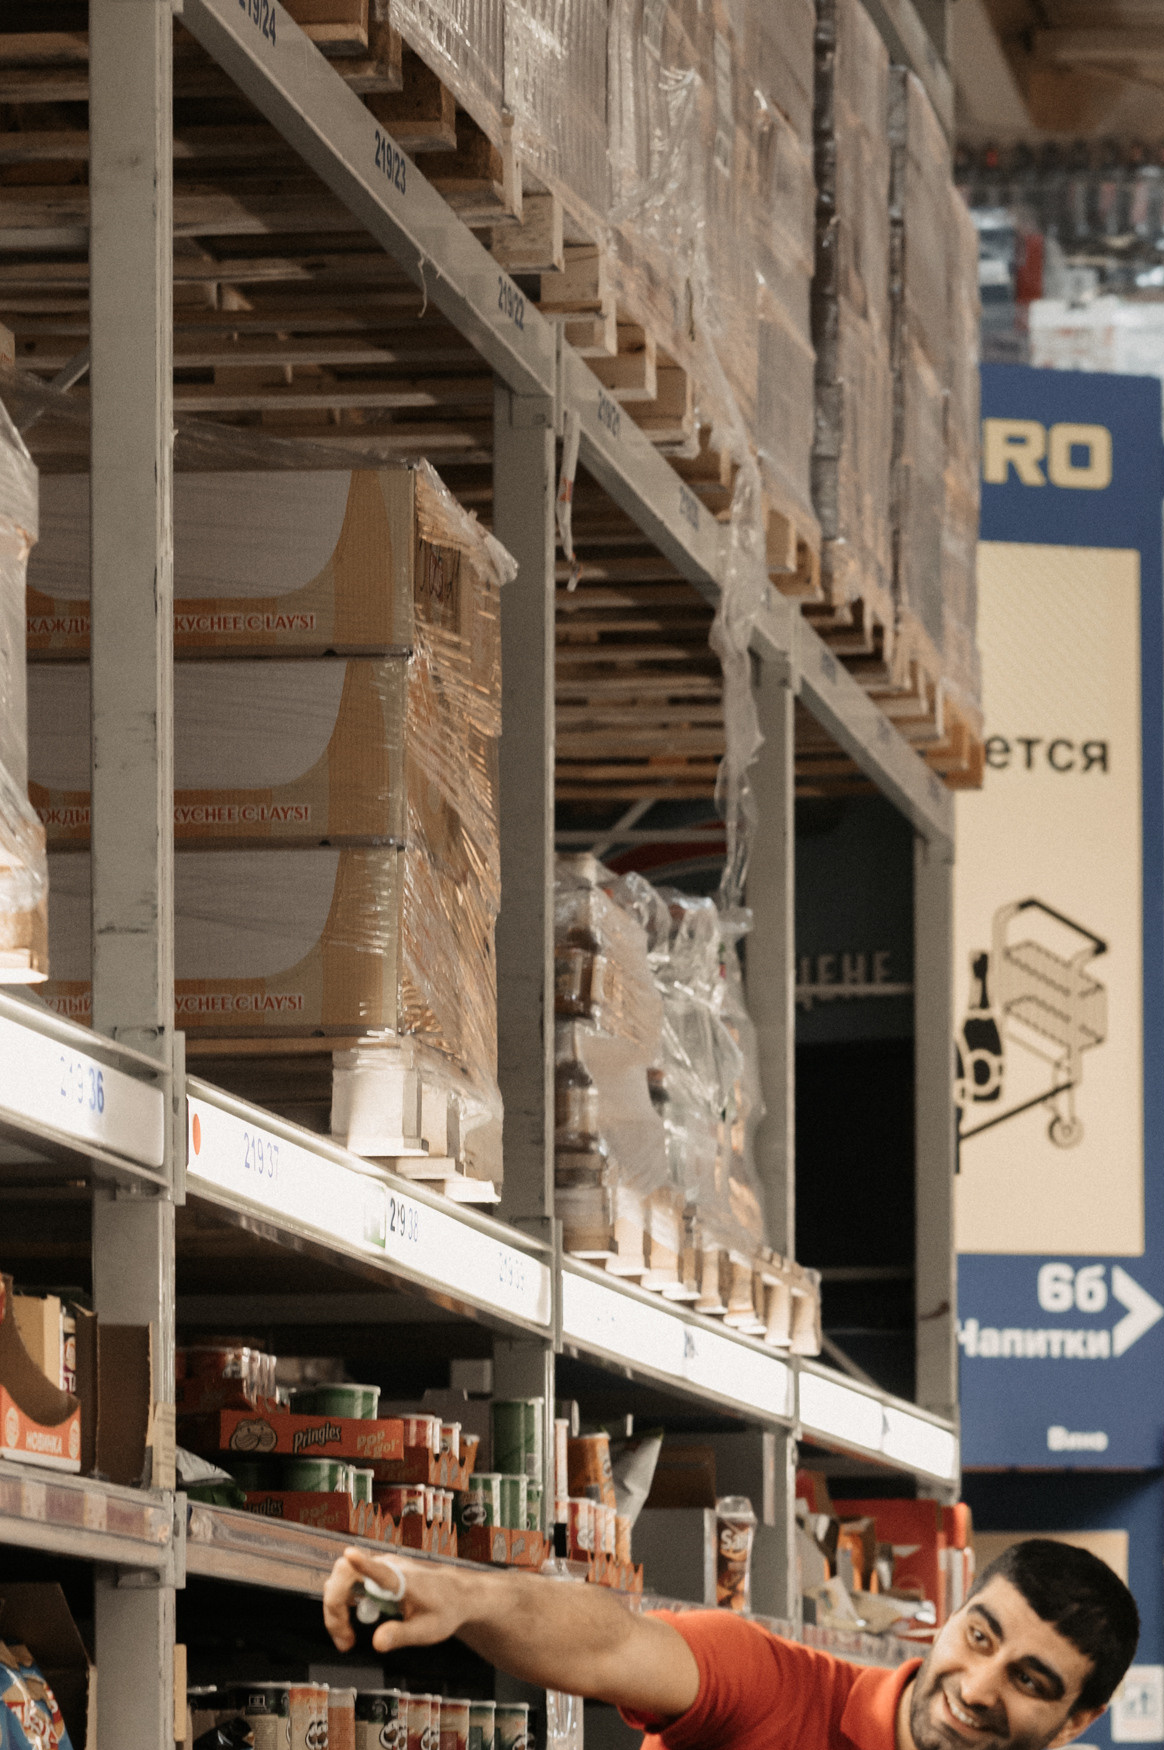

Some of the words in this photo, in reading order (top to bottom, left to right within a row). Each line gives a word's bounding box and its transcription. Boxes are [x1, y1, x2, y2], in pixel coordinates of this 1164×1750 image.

[239, 0, 275, 46] 9/24
[375, 129, 405, 195] 219/23
[983, 418, 1112, 490] RO
[985, 735, 1107, 772] ется
[293, 1421, 342, 1453] Pringles
